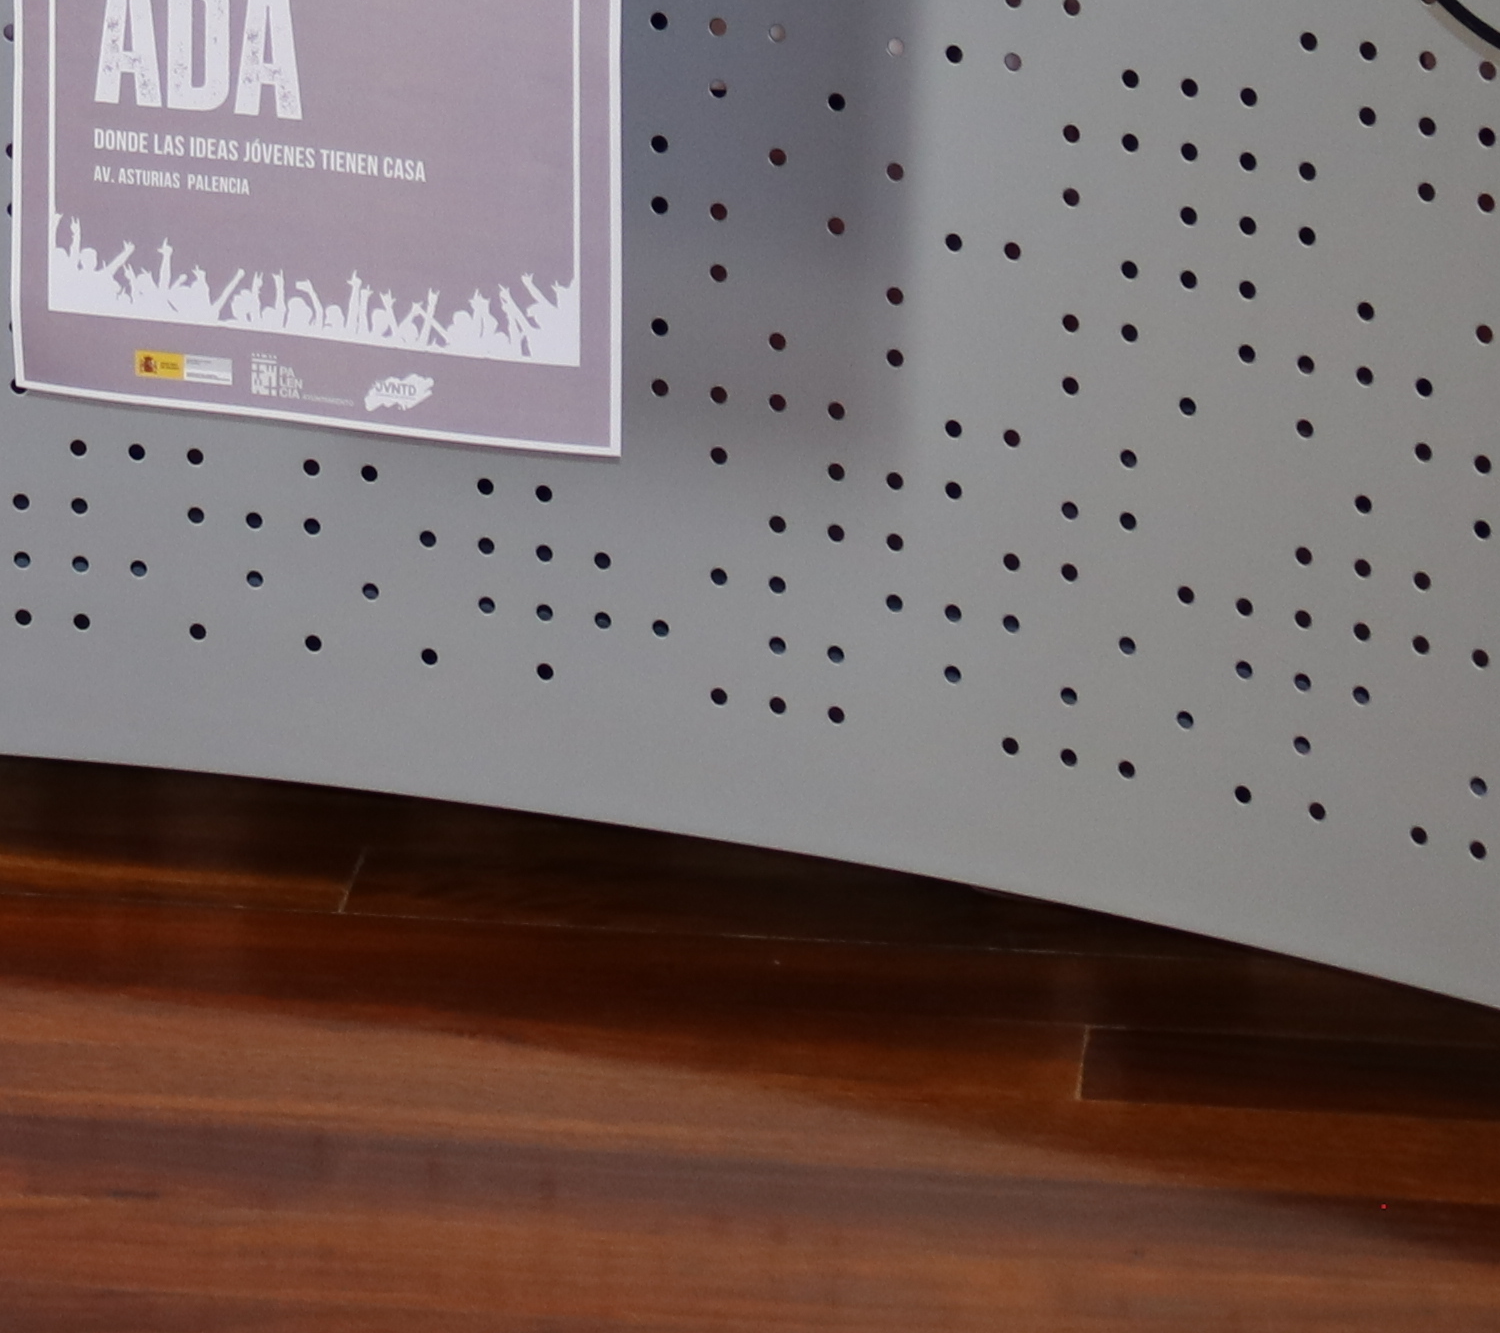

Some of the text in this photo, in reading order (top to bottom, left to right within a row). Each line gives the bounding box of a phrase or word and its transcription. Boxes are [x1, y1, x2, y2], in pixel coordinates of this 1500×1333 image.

[93, 128, 426, 183] DONDE LAS IDEAS JÓVENES TIENEN CASA
[94, 165, 250, 196] AV. ASTURIAS PALENCIA
[375, 381, 417, 396] JVNTD
